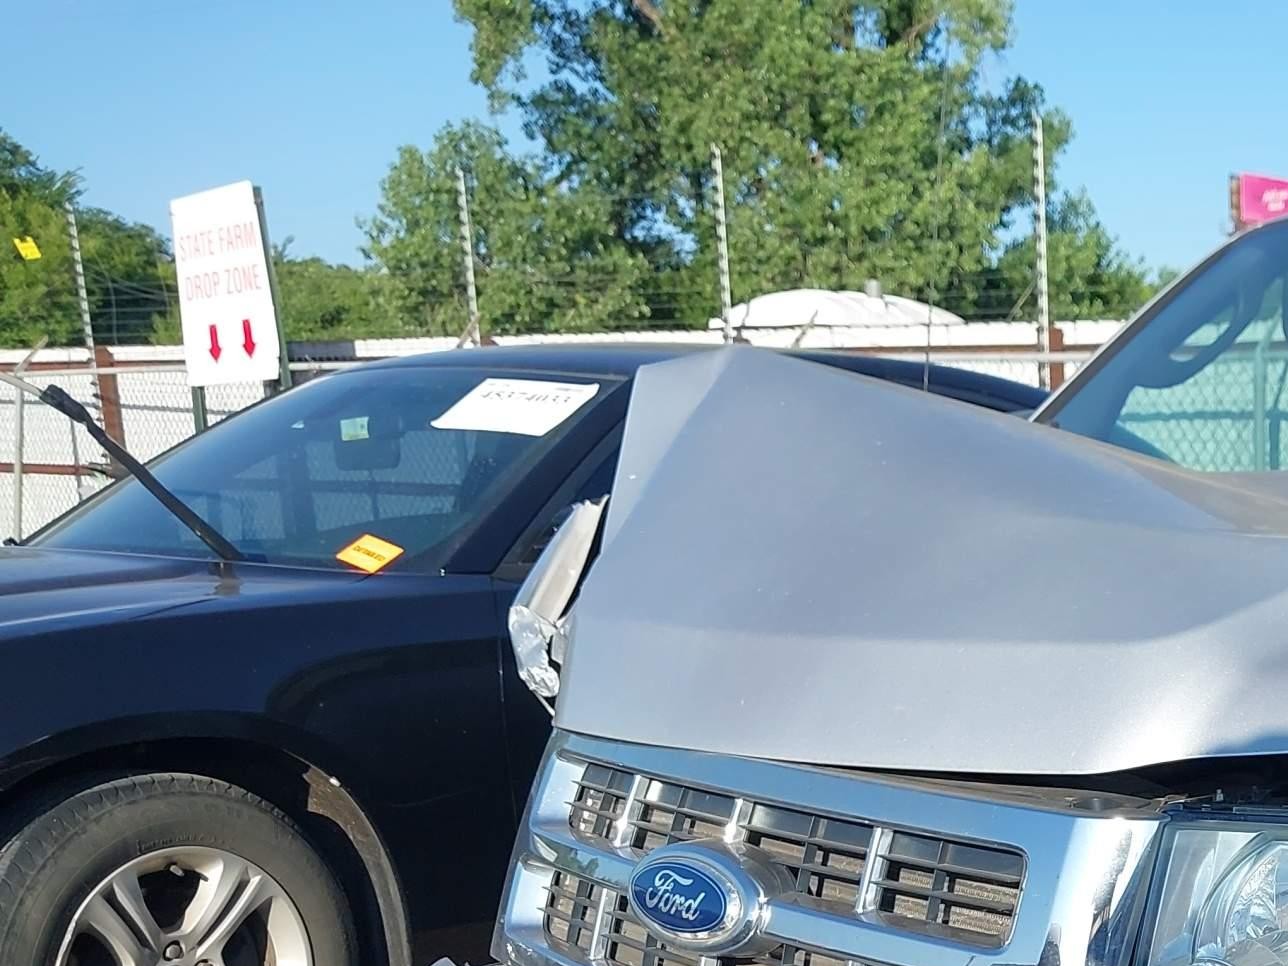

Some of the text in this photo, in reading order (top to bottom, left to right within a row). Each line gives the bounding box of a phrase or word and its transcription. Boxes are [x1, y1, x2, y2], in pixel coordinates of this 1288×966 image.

[180, 222, 256, 261] STATE FARM
[186, 264, 261, 300] DROP ZONE
[645, 869, 706, 921] Ford
